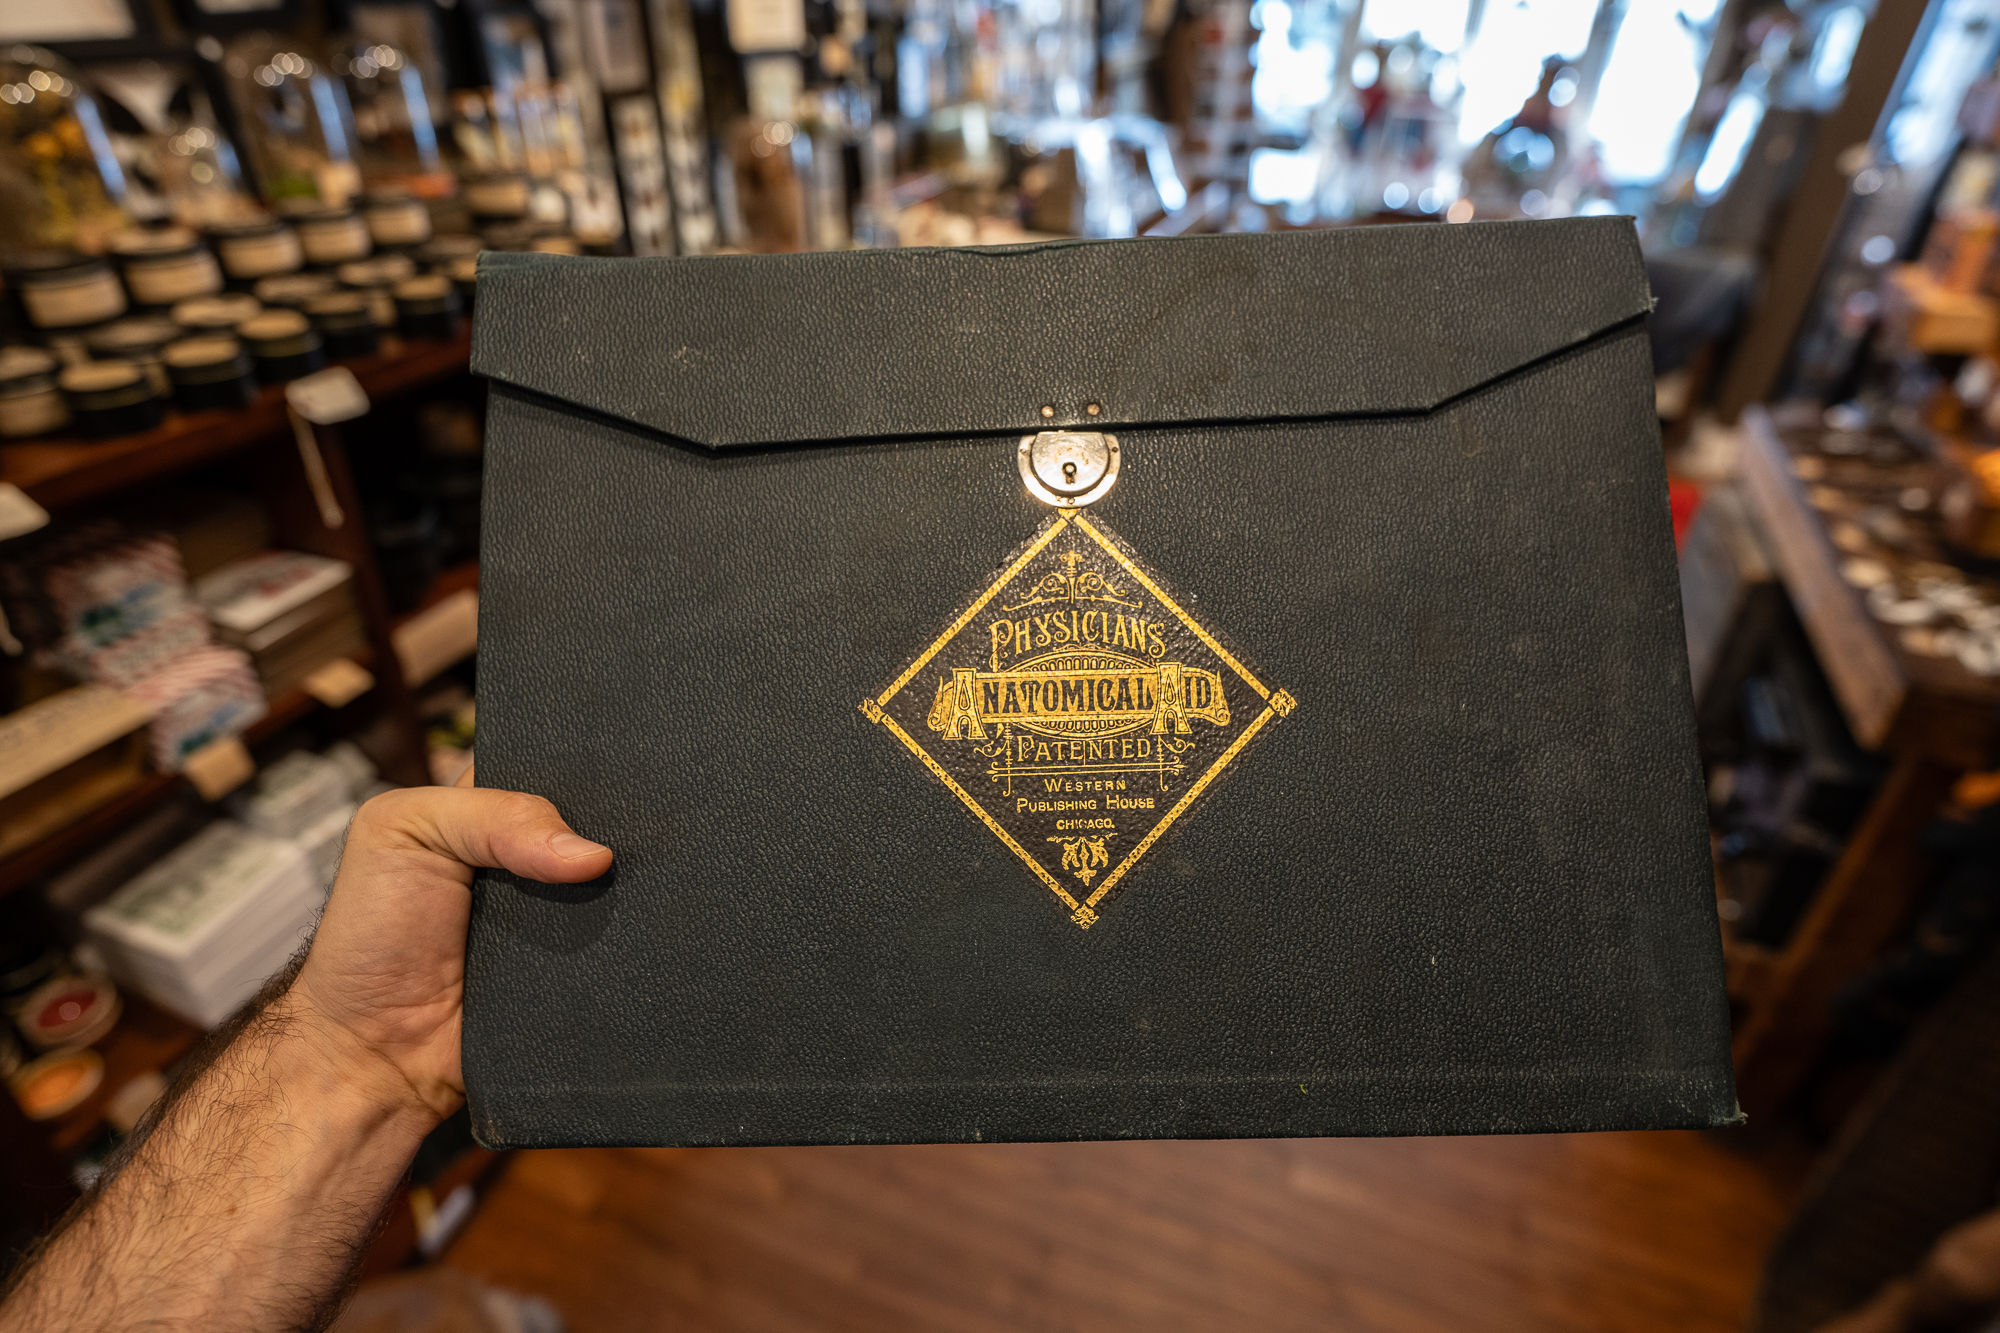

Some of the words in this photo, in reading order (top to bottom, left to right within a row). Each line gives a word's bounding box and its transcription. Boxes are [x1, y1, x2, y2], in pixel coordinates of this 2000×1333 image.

[988, 610, 1165, 671] PHYSICIANS
[943, 667, 1155, 740] ANATOMICAL
[1149, 662, 1212, 734] AID
[1017, 735, 1152, 763] PATENTED
[1044, 779, 1127, 793] WESTERN
[1017, 798, 1097, 814] PUBLISHING
[1106, 794, 1155, 810] HOUSE
